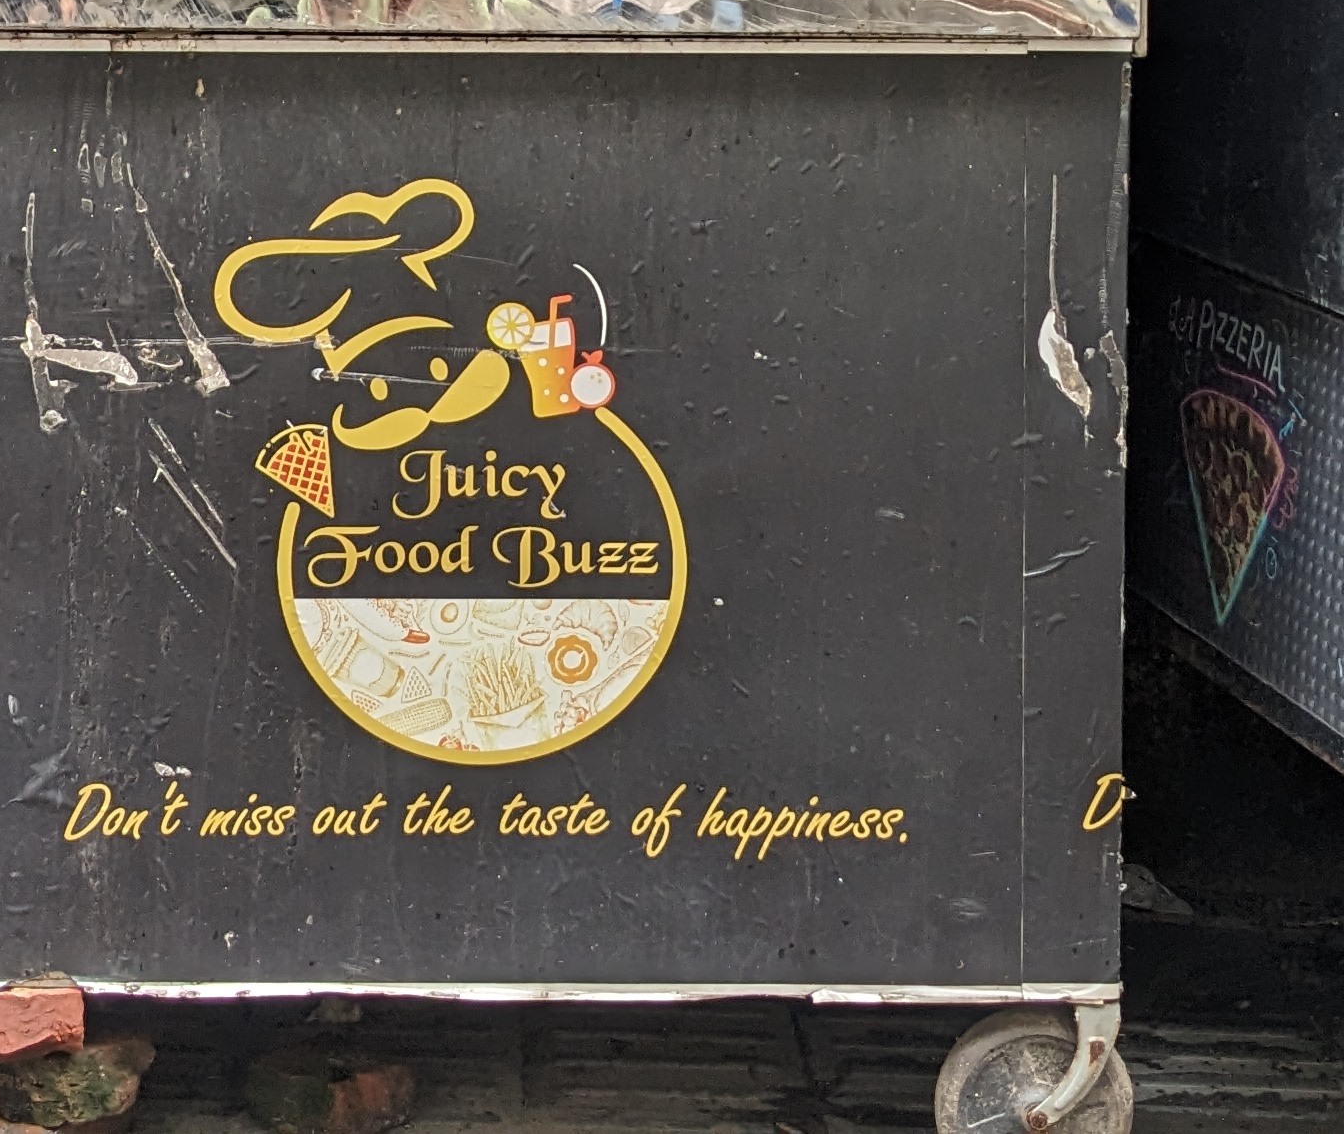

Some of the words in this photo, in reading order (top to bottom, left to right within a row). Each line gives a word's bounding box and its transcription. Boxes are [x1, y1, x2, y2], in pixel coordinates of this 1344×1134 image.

[392, 449, 566, 520] Juicy
[303, 524, 480, 588] Food
[492, 526, 659, 588] Buzz
[64, 781, 188, 842] Don't
[200, 793, 294, 837] miss
[313, 793, 387, 836] out
[403, 784, 474, 836] the
[499, 793, 609, 836] taste
[631, 783, 686, 858] of
[697, 786, 907, 862] happiness.
